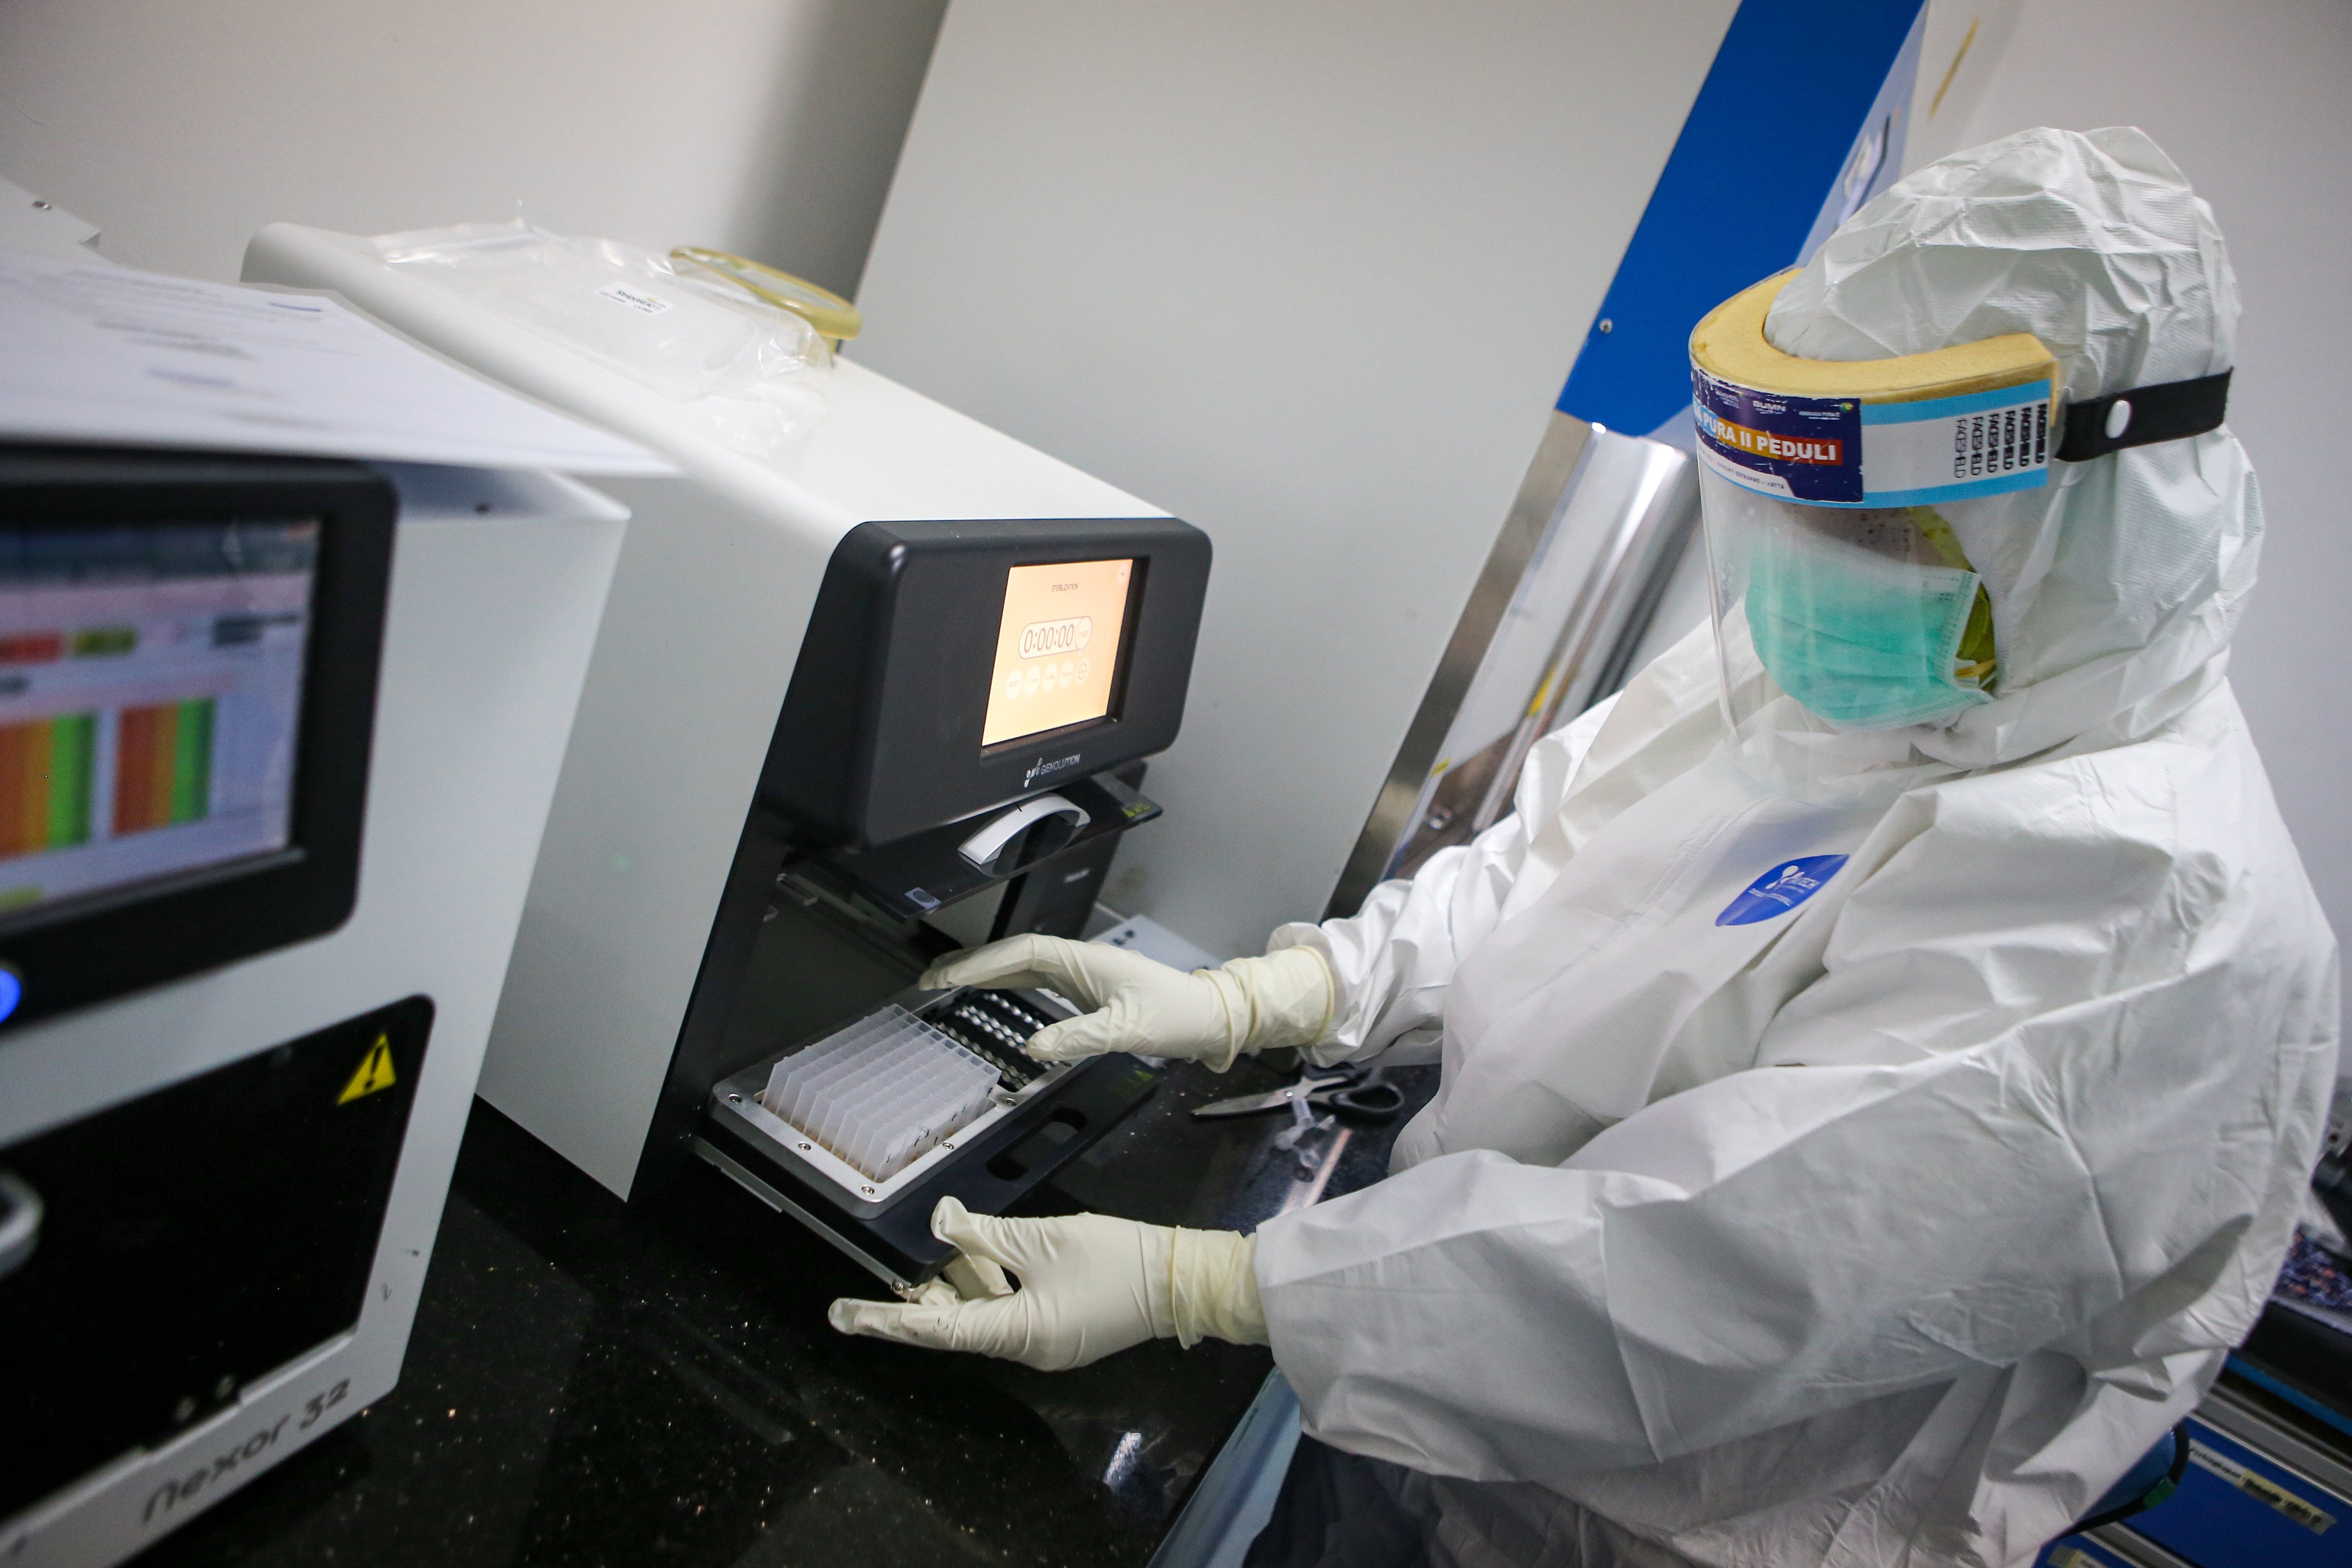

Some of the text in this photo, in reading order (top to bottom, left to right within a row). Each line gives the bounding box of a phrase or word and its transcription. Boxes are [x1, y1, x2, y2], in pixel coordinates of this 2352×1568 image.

[1753, 400, 1786, 412] BUMN
[1702, 411, 1737, 443] PURA
[1756, 436, 1836, 461] PEDULI
[1051, 583, 1078, 591] STERILIZATION
[1024, 624, 1074, 654] 0:00:00
[299, 1378, 350, 1430] 32
